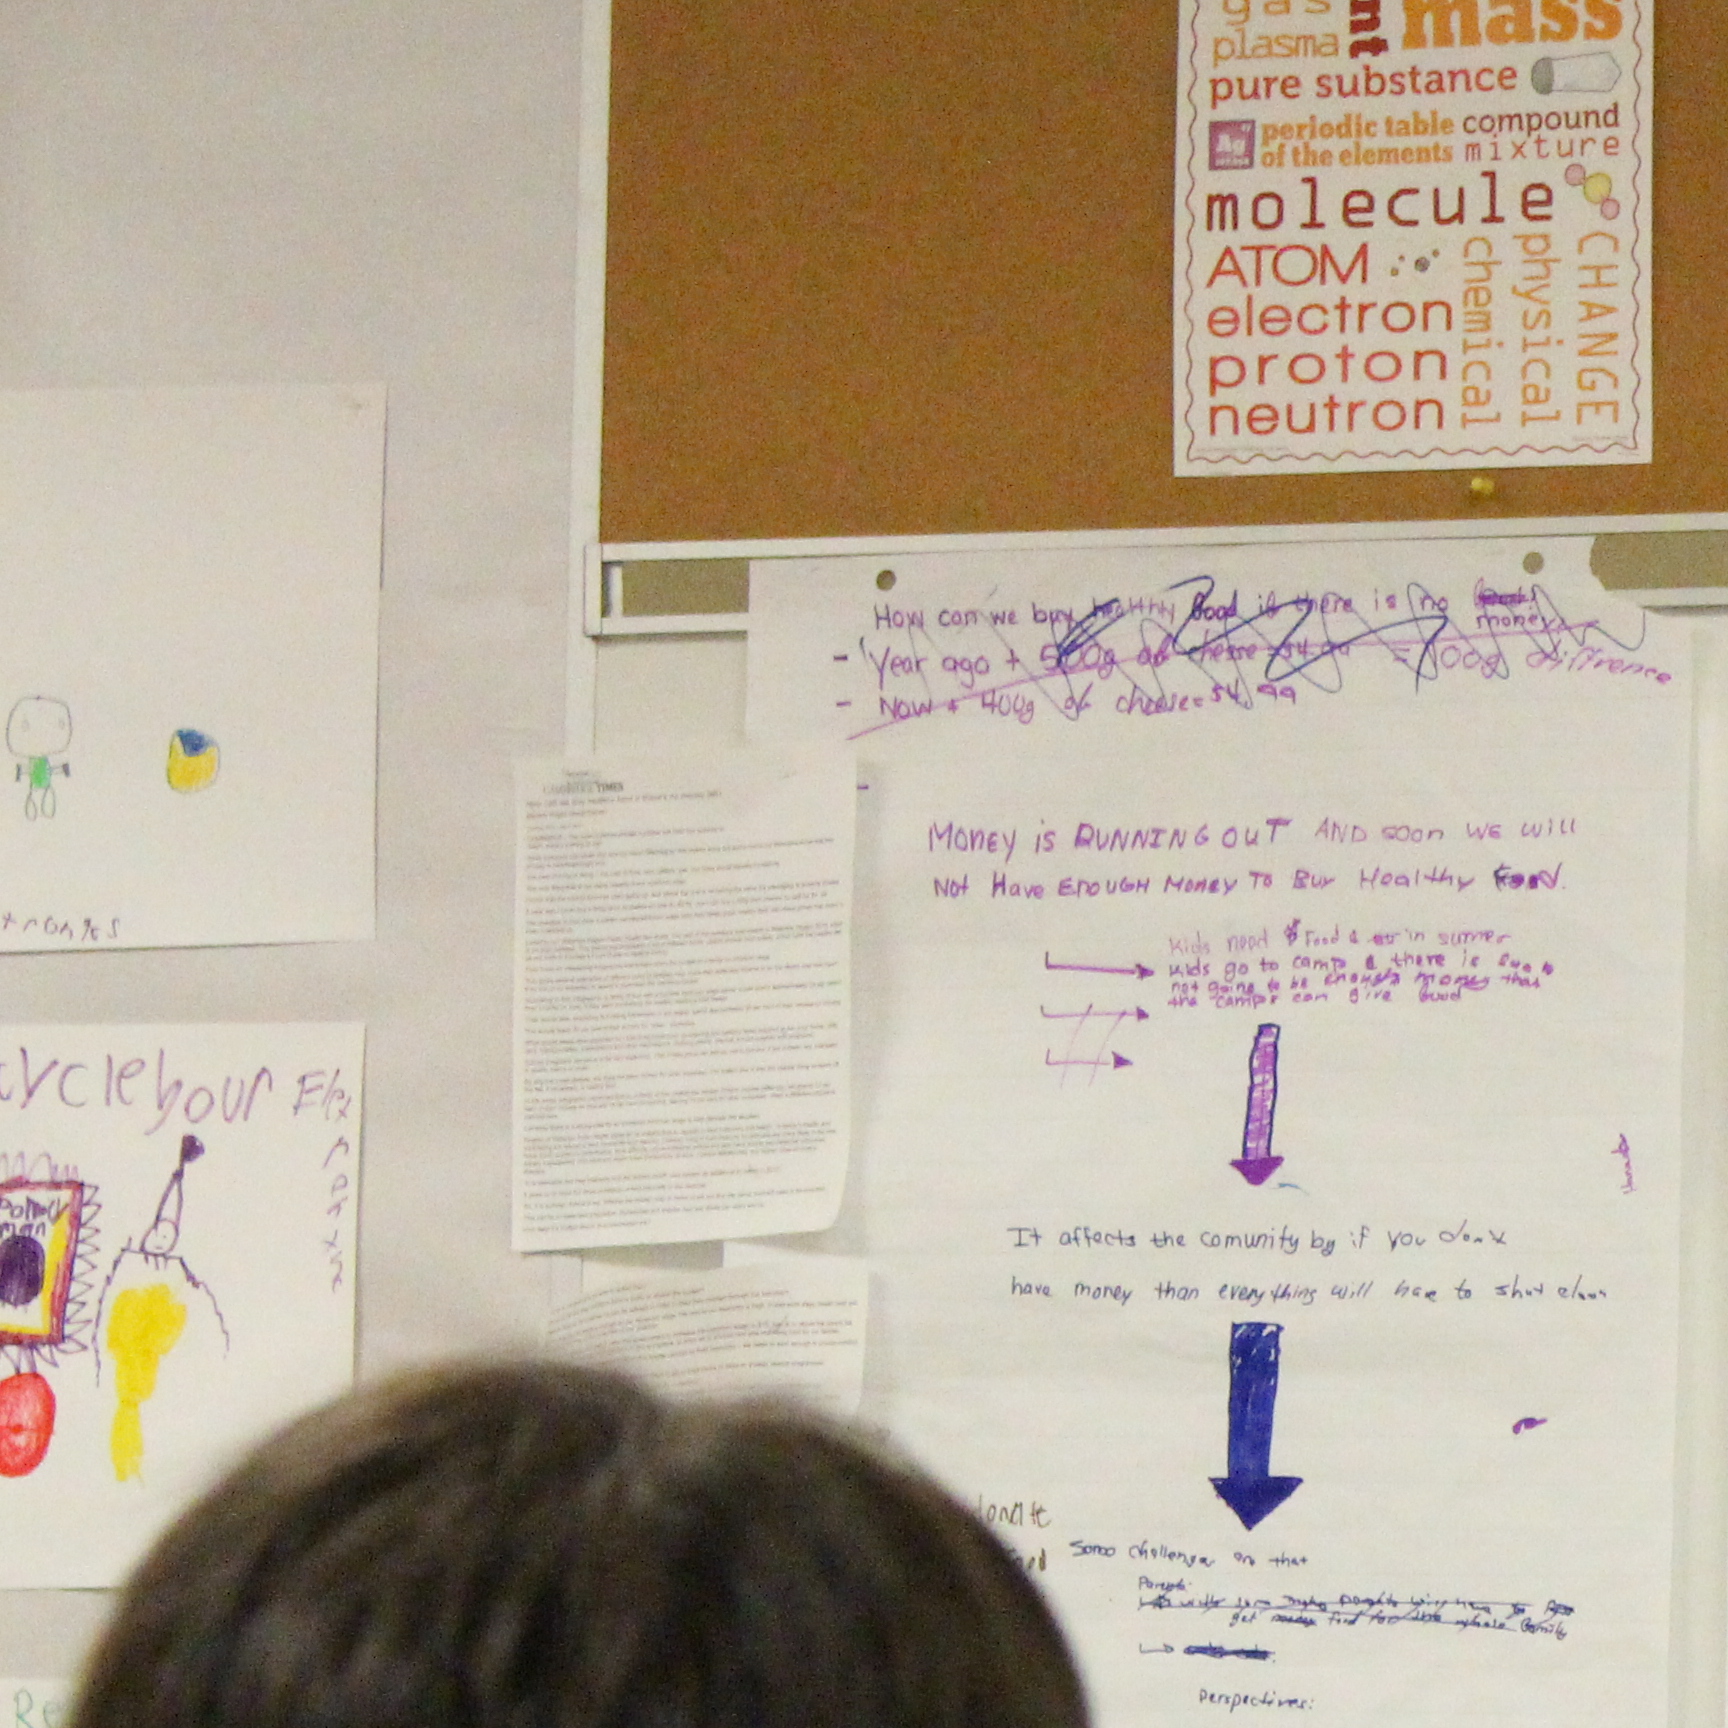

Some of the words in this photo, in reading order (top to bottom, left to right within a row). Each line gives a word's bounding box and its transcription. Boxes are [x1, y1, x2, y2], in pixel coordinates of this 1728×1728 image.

[1213, 28, 1339, 69] plasma
[1209, 75, 1302, 109] pure
[1316, 64, 1518, 98] substance
[1261, 113, 1379, 147] periodic
[1384, 111, 1454, 137] table
[1463, 103, 1620, 135] compound
[1261, 142, 1286, 168] of
[1292, 141, 1333, 167] the
[1339, 141, 1453, 166] elements
[1465, 132, 1621, 163] mixture
[1206, 171, 1554, 232] molecule
[1207, 243, 1368, 289] ATOM
[1207, 295, 1452, 337] electron
[1461, 237, 1502, 430] chemical
[1513, 232, 1563, 428] physical
[1577, 231, 1620, 424] CHANGE
[1209, 346, 1448, 397] proton
[1209, 397, 1445, 437] neutron
[1007, 1227, 1042, 1248] It
[1149, 1229, 1187, 1248] the
